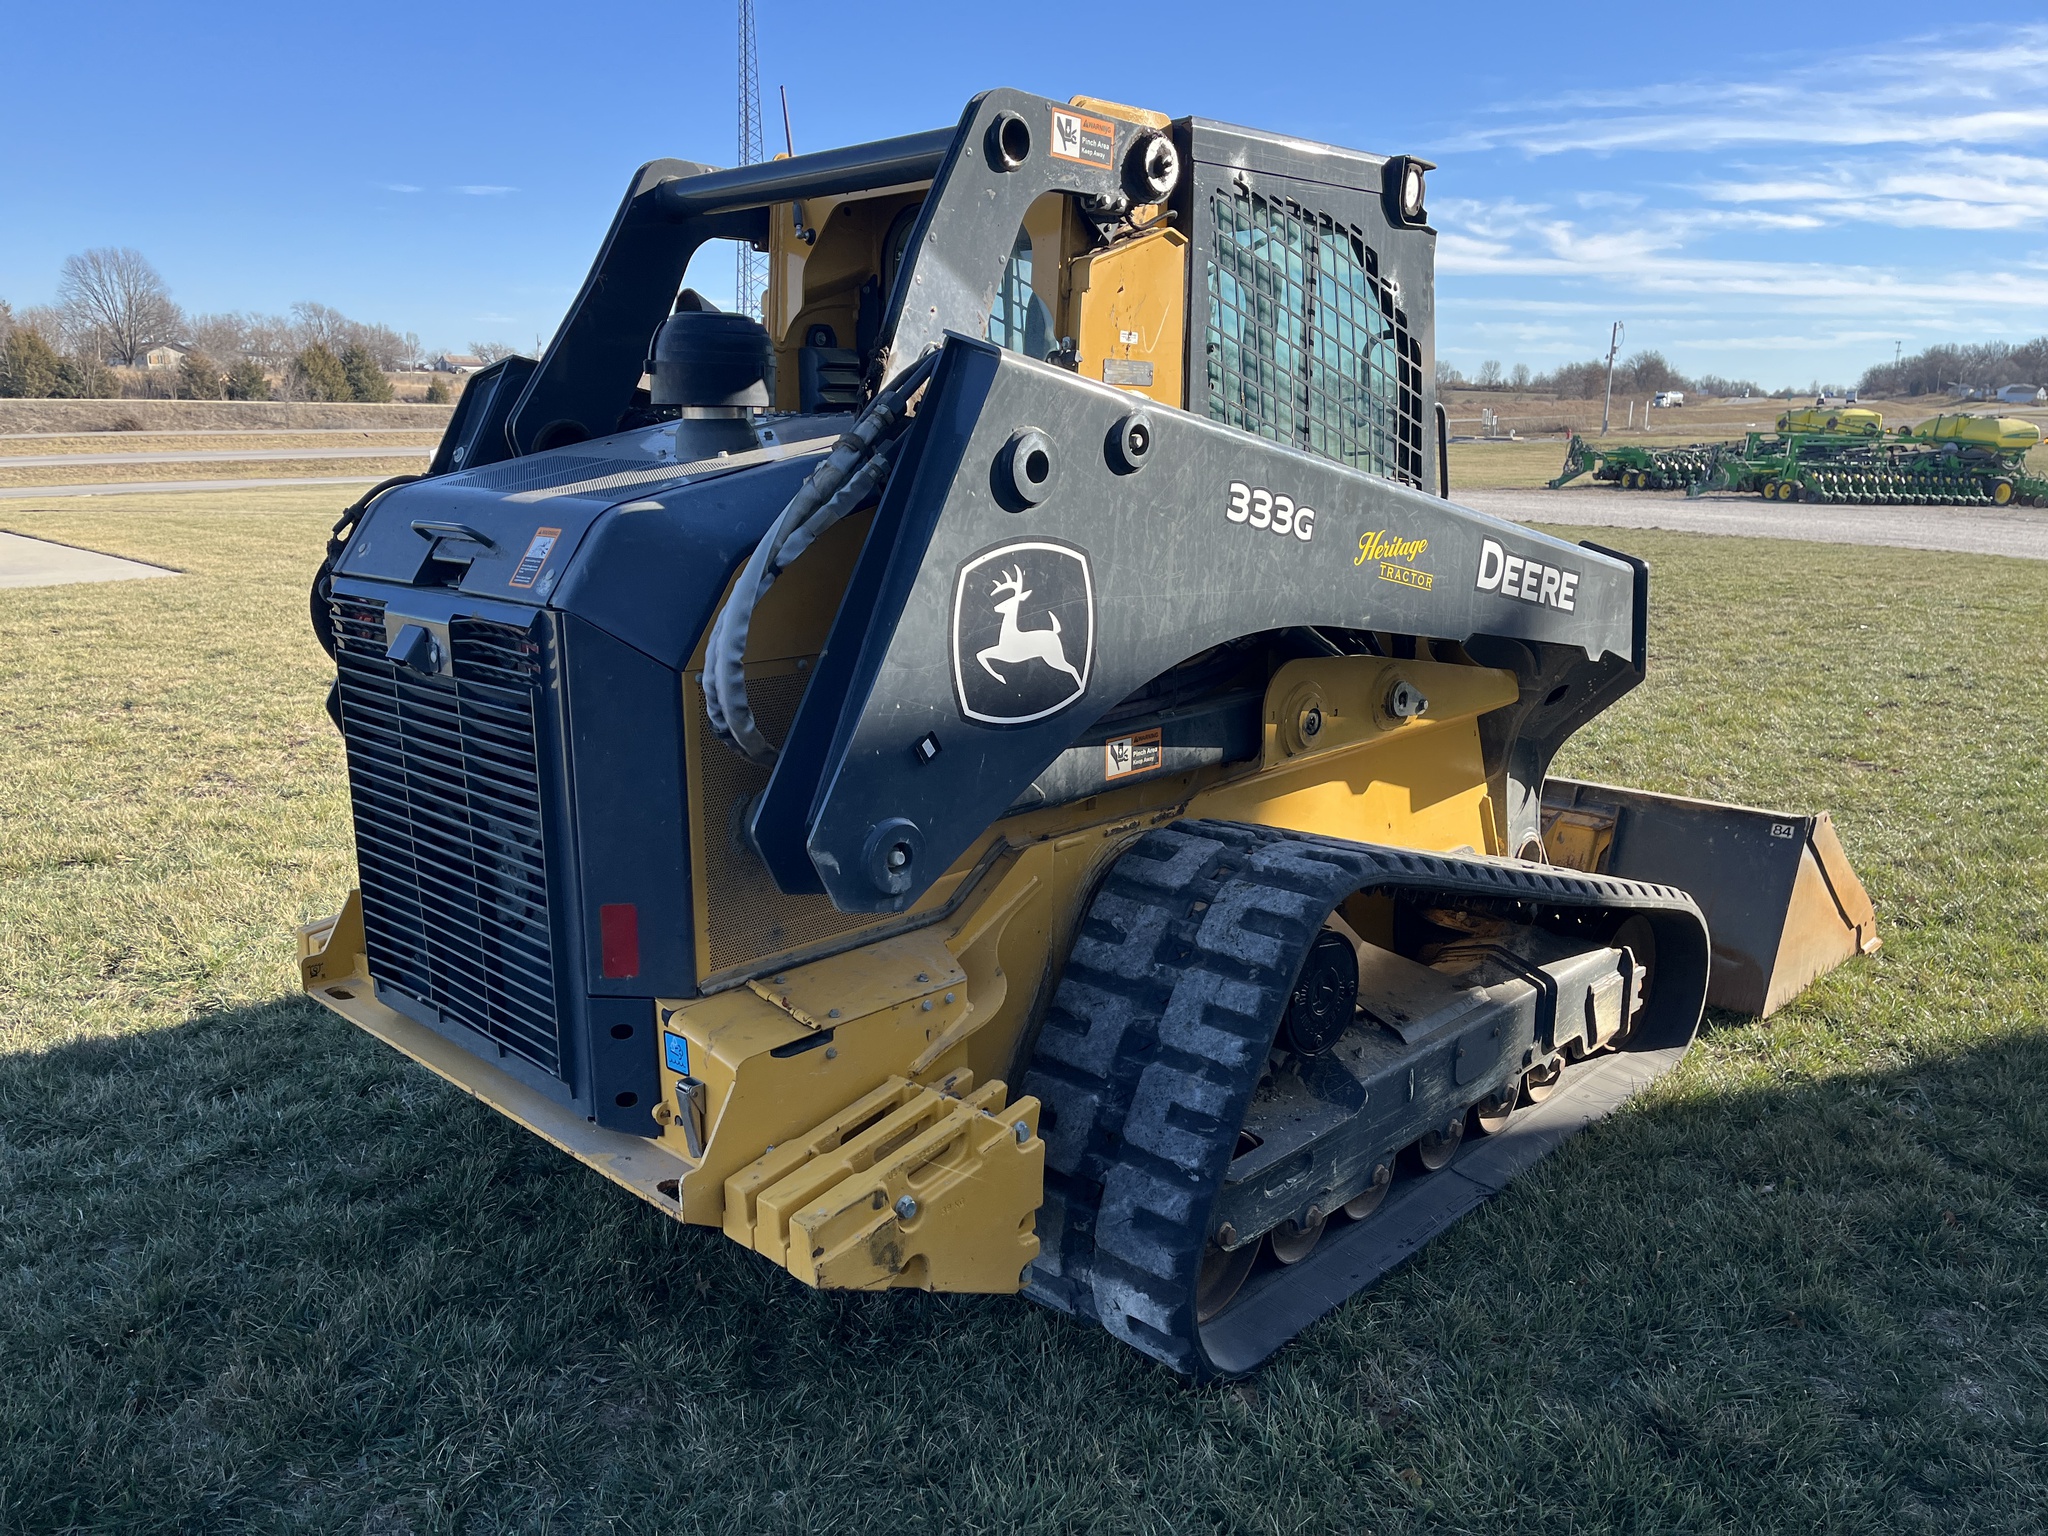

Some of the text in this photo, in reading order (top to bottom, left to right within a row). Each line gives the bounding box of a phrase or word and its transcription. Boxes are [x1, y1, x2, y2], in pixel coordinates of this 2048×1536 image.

[1081, 136, 1110, 150] Pinch Area
[1081, 146, 1106, 160] Keep Away
[1226, 482, 1315, 541] 333G
[1353, 529, 1429, 566] Heritage
[1380, 564, 1433, 588] TRACTOR
[1476, 538, 1579, 612] DEERE
[1772, 824, 1792, 837] 84
